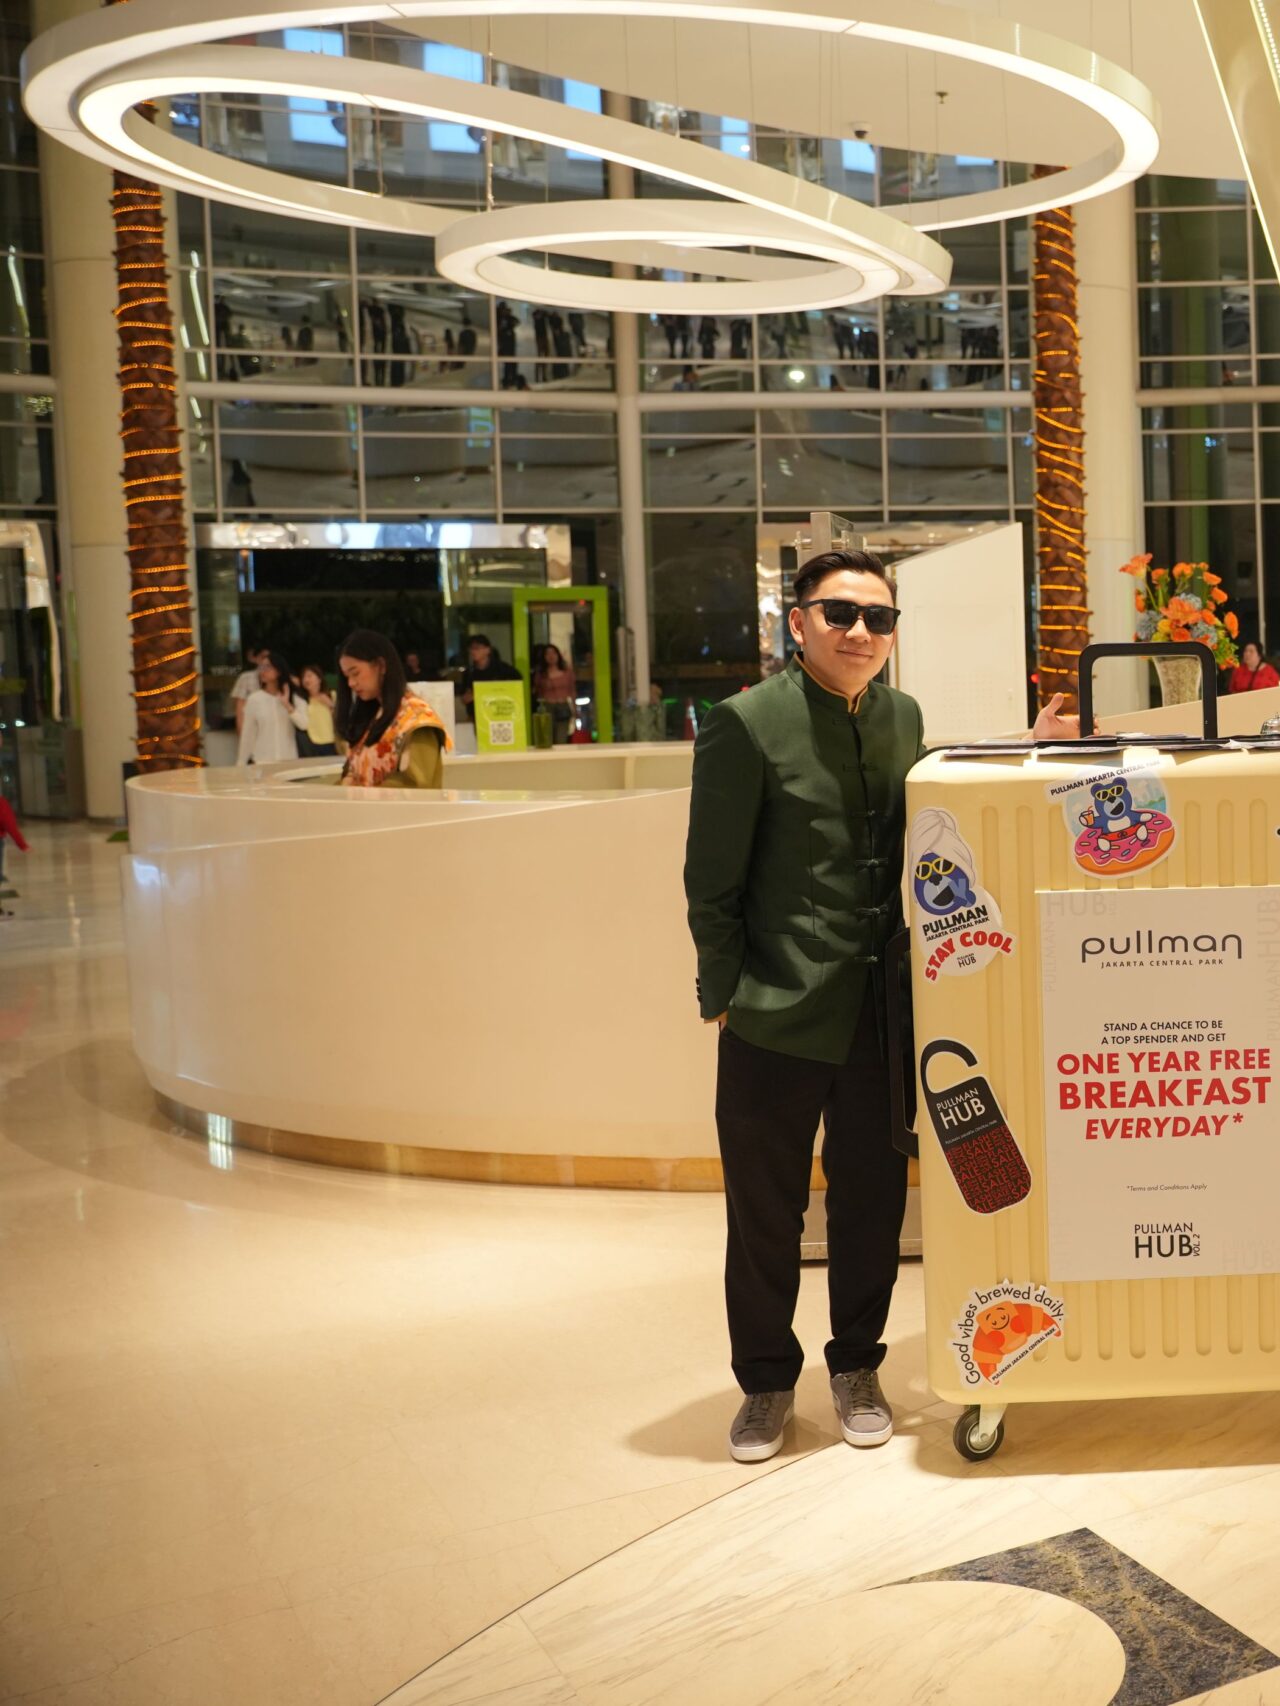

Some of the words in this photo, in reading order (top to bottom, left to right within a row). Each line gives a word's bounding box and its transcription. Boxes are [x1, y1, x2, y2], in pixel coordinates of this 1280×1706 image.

[1050, 779, 1084, 796] PULLMAN
[1085, 771, 1115, 785] JAKARTA
[922, 905, 988, 936] PULLMAN
[926, 931, 948, 942] JAKARTA
[949, 923, 973, 934] CENTRAL
[975, 917, 990, 926] PARK
[925, 938, 956, 981] STAY
[960, 931, 1013, 954] COOL
[1081, 930, 1242, 963] pullman
[958, 957, 976, 968] HUB
[1101, 961, 1145, 969] JAKARTA
[1104, 1022, 1137, 1032] STAND
[1140, 1022, 1148, 1031] A
[1150, 1021, 1193, 1030] CHANCE
[1195, 1020, 1209, 1029] TO
[1211, 1020, 1223, 1029] BE
[1101, 1036, 1109, 1045] A
[1112, 1035, 1131, 1045] TOP
[1133, 1034, 1178, 1044] SPENDER
[1181, 1033, 1205, 1043] AND
[1207, 1033, 1226, 1042] GET
[1057, 1053, 1120, 1075] ONE
[1127, 1051, 1201, 1073] YEAR
[1210, 1048, 1270, 1071] FREE
[936, 1088, 979, 1111] PULLMAN
[1059, 1076, 1271, 1110] BREAKFAST
[940, 1098, 986, 1130] HUB
[1190, 1183, 1208, 1191] Apply
[1134, 1222, 1193, 1234] PULLMAN
[1134, 1234, 1193, 1259] HUB
[975, 1286, 1031, 1305] brewed
[1034, 1290, 1064, 1321] daily.
[957, 1303, 978, 1339] vibes
[953, 1342, 981, 1384] Good
[991, 1363, 1012, 1381] PULLMAN
[1012, 1350, 1029, 1366] JAKARTA
[1028, 1337, 1046, 1352] CENTRAL
[1045, 1327, 1056, 1338] PARK
